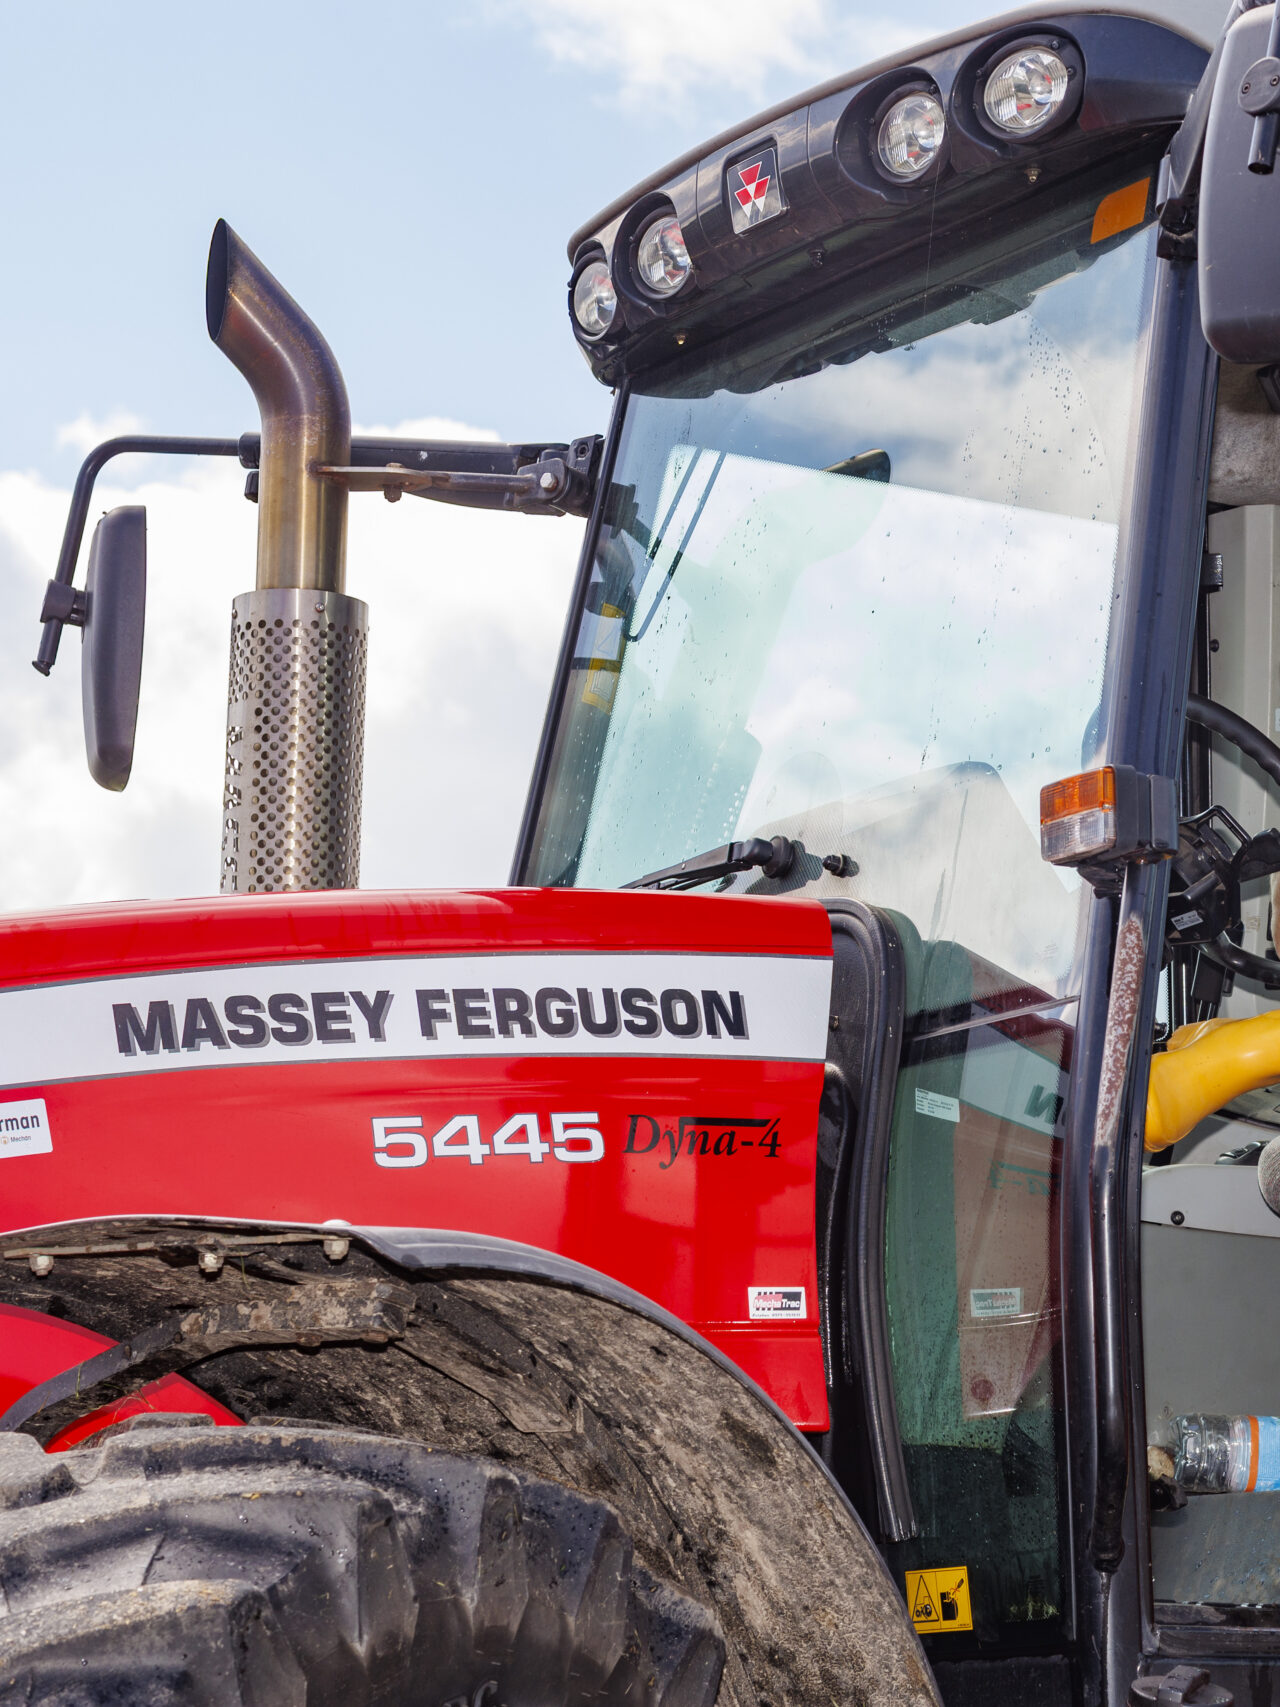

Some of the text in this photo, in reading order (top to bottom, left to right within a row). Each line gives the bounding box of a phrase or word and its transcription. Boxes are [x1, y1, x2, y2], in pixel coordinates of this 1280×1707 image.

[112, 987, 750, 1057] MASSEY FERGUSON
[371, 1112, 782, 1170] 5445 Dyna-4
[754, 1298, 800, 1308] MechaTrac
